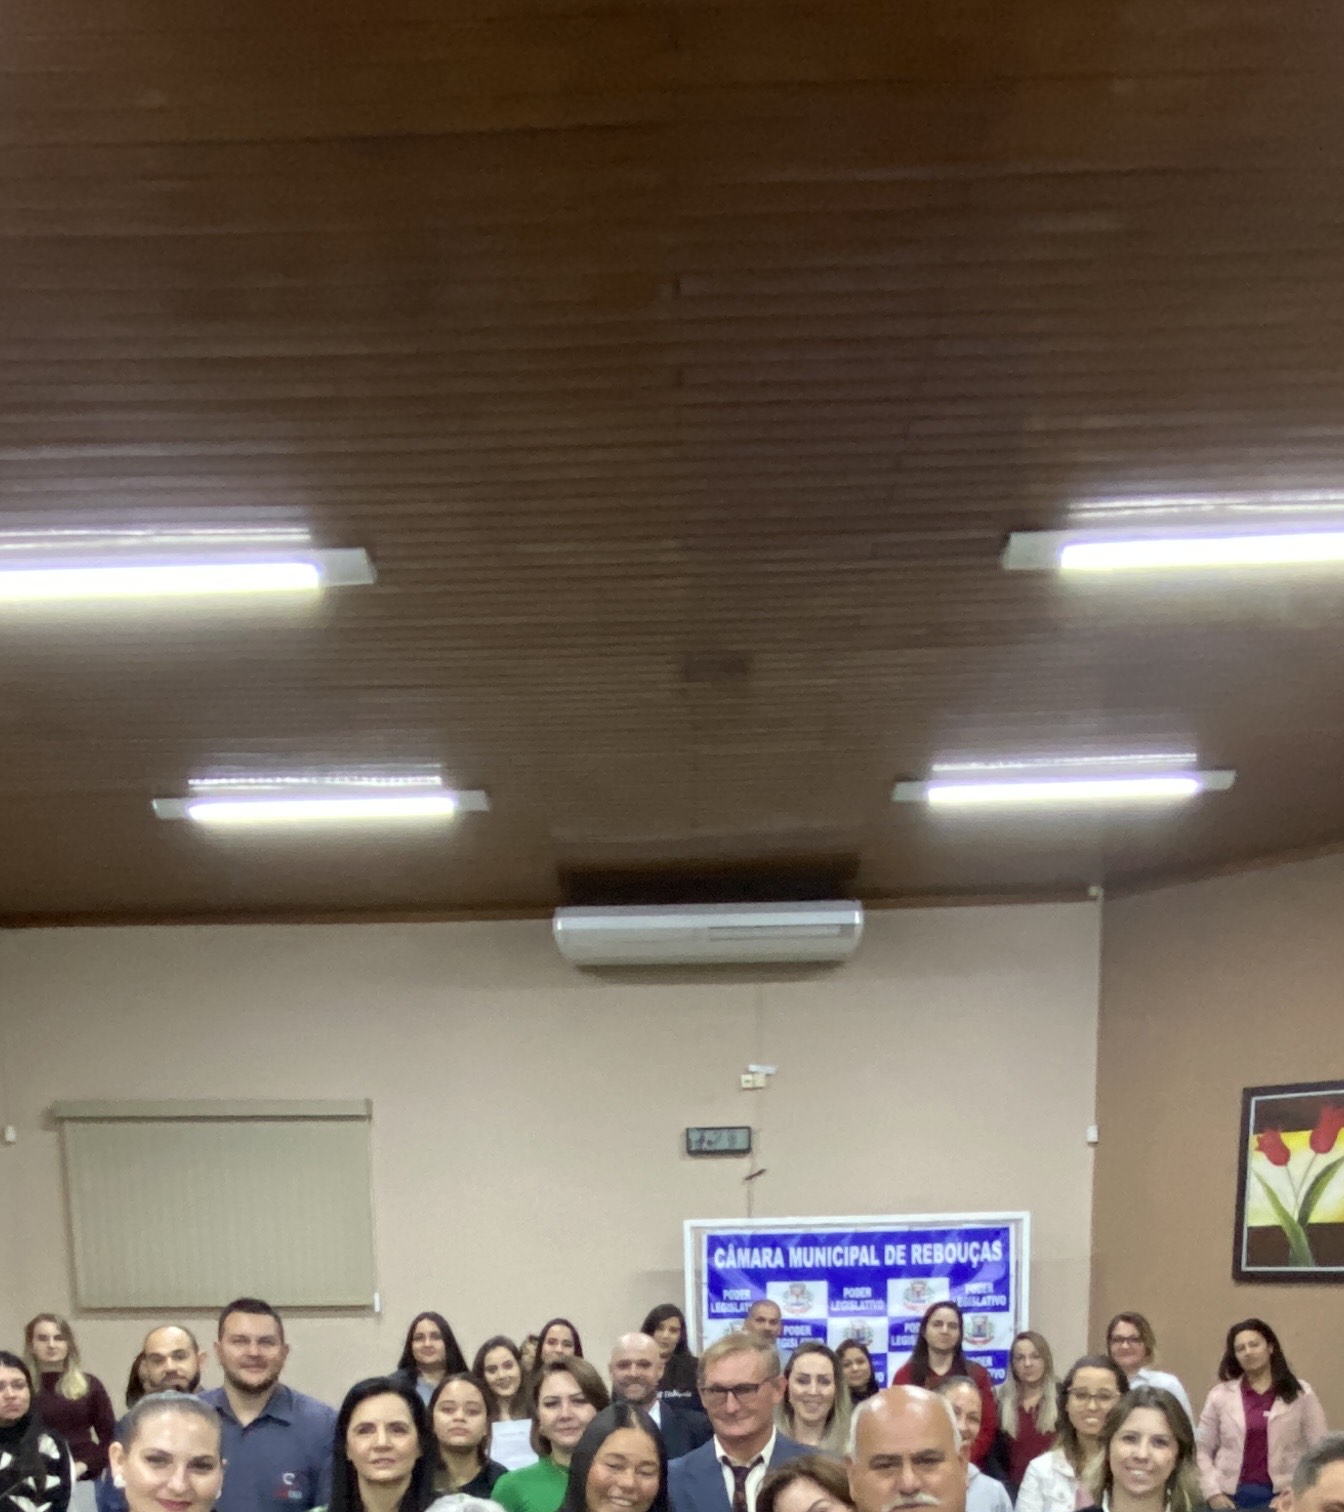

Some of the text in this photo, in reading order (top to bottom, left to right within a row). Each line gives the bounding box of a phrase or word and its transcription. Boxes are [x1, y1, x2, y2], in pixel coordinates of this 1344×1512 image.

[714, 1240, 1002, 1269] CÂMARA MUNICIPAL DE REBOUÇAS
[843, 1287, 871, 1298] PODER
